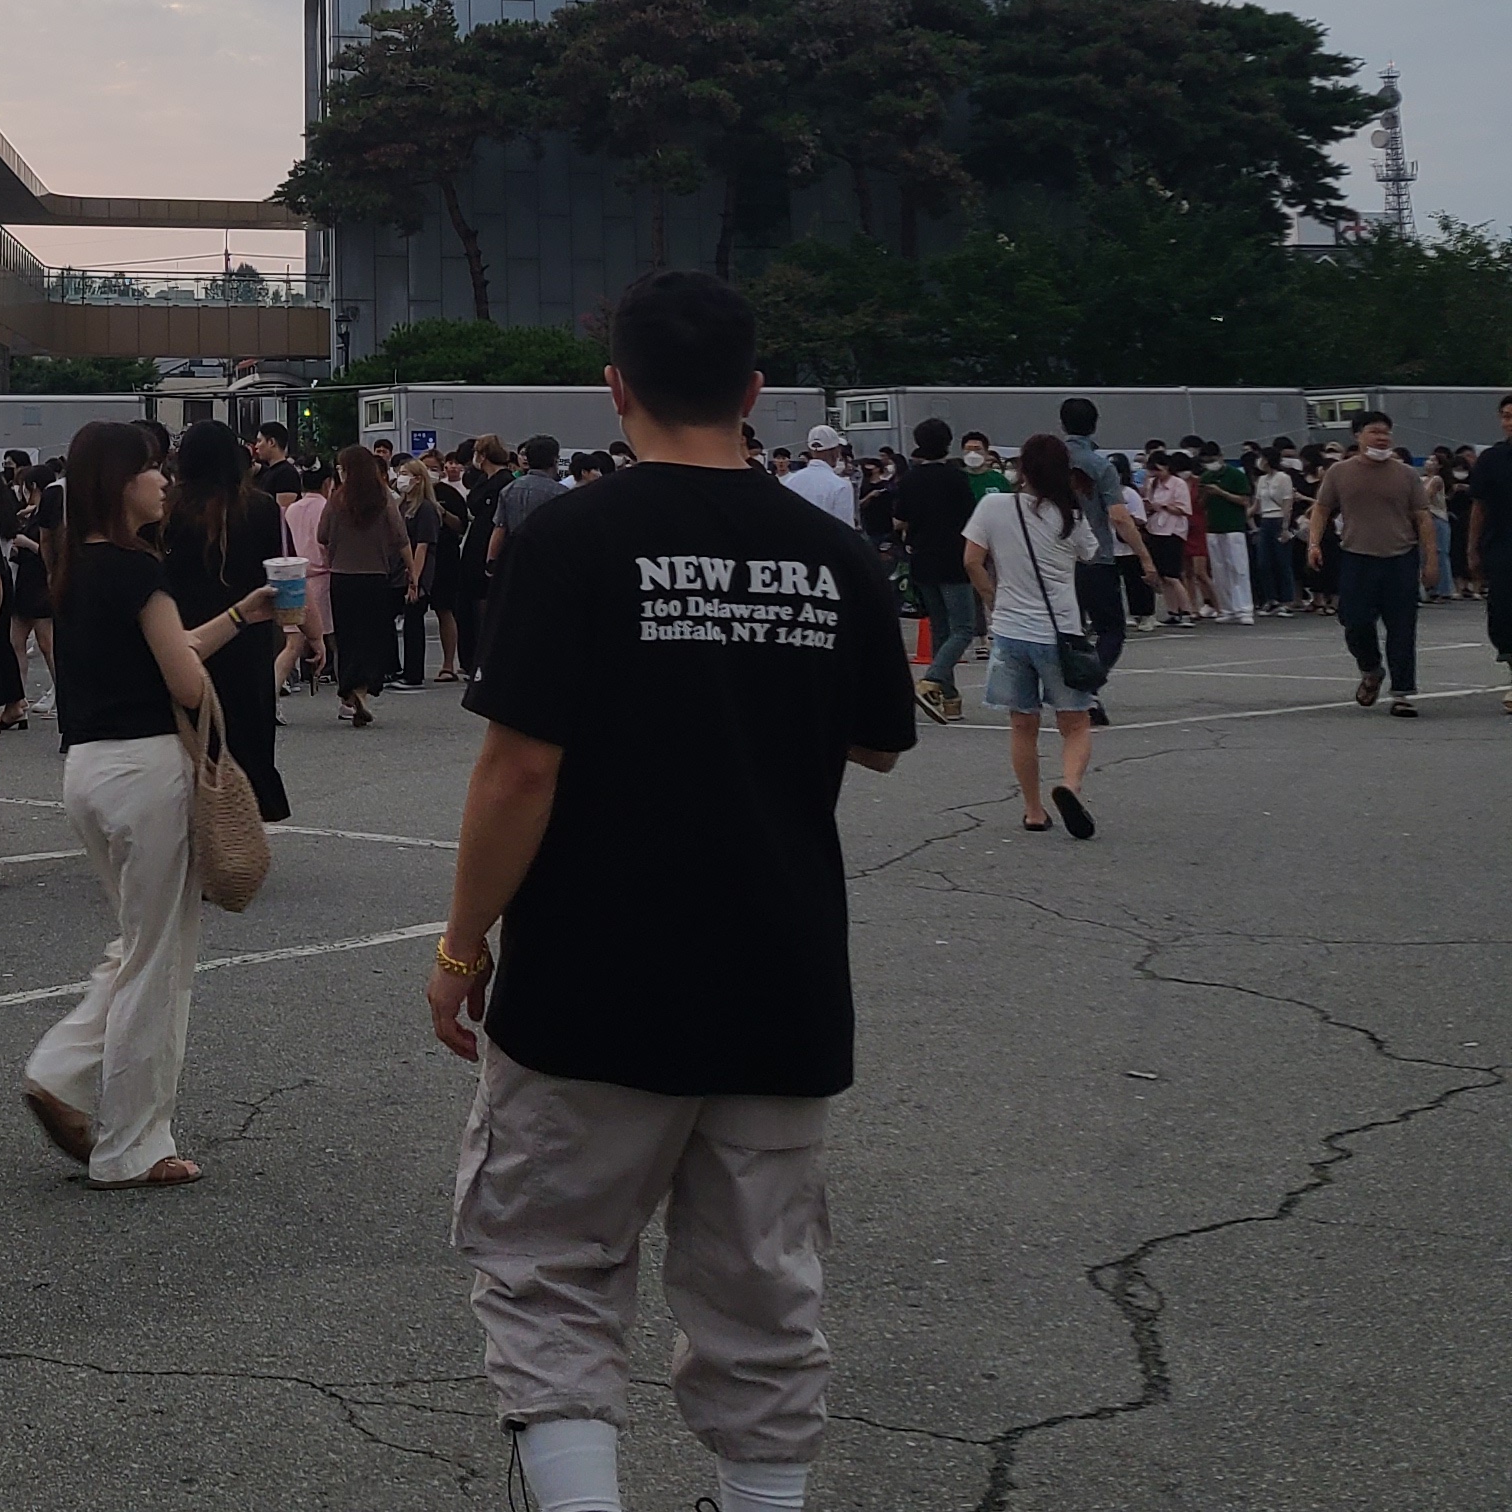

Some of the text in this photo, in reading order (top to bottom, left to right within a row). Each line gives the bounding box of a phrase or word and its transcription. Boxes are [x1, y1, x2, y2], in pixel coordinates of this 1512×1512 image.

[635, 555, 841, 600] NEW ERA
[640, 596, 838, 626] 160 Delaware Ave
[639, 620, 837, 650] Buffalo, NY 14201
